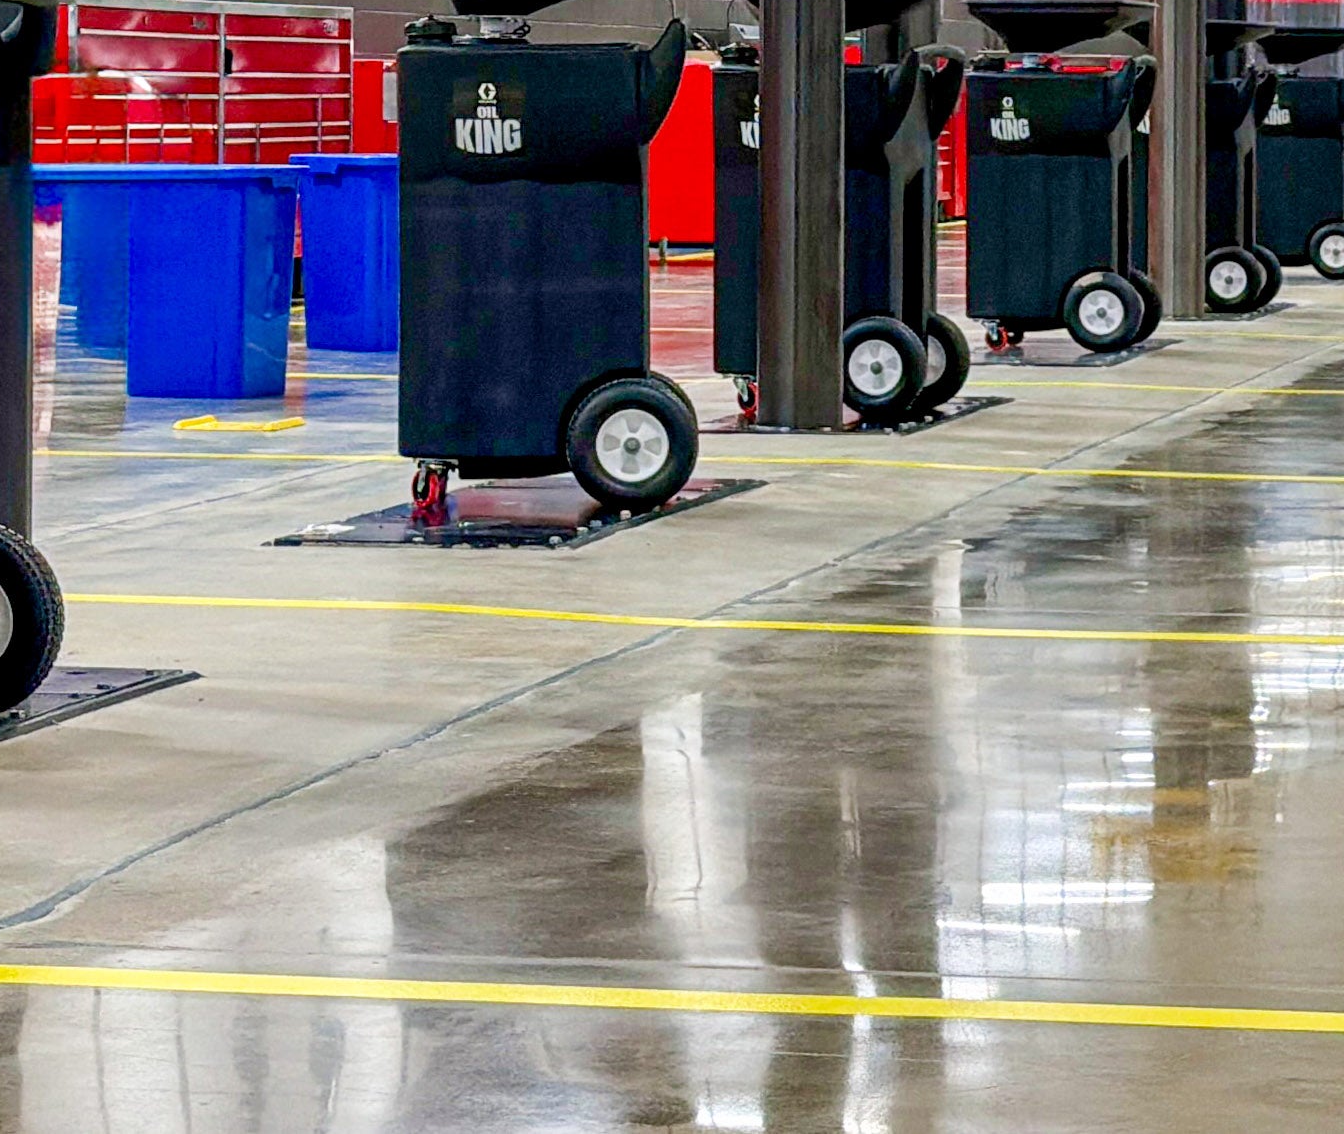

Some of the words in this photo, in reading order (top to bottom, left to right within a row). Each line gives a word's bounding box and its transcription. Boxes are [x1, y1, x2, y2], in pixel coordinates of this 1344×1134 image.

[476, 105, 499, 119] OIL
[455, 117, 522, 155] KING
[740, 120, 760, 149] KI
[989, 117, 1031, 141] KING
